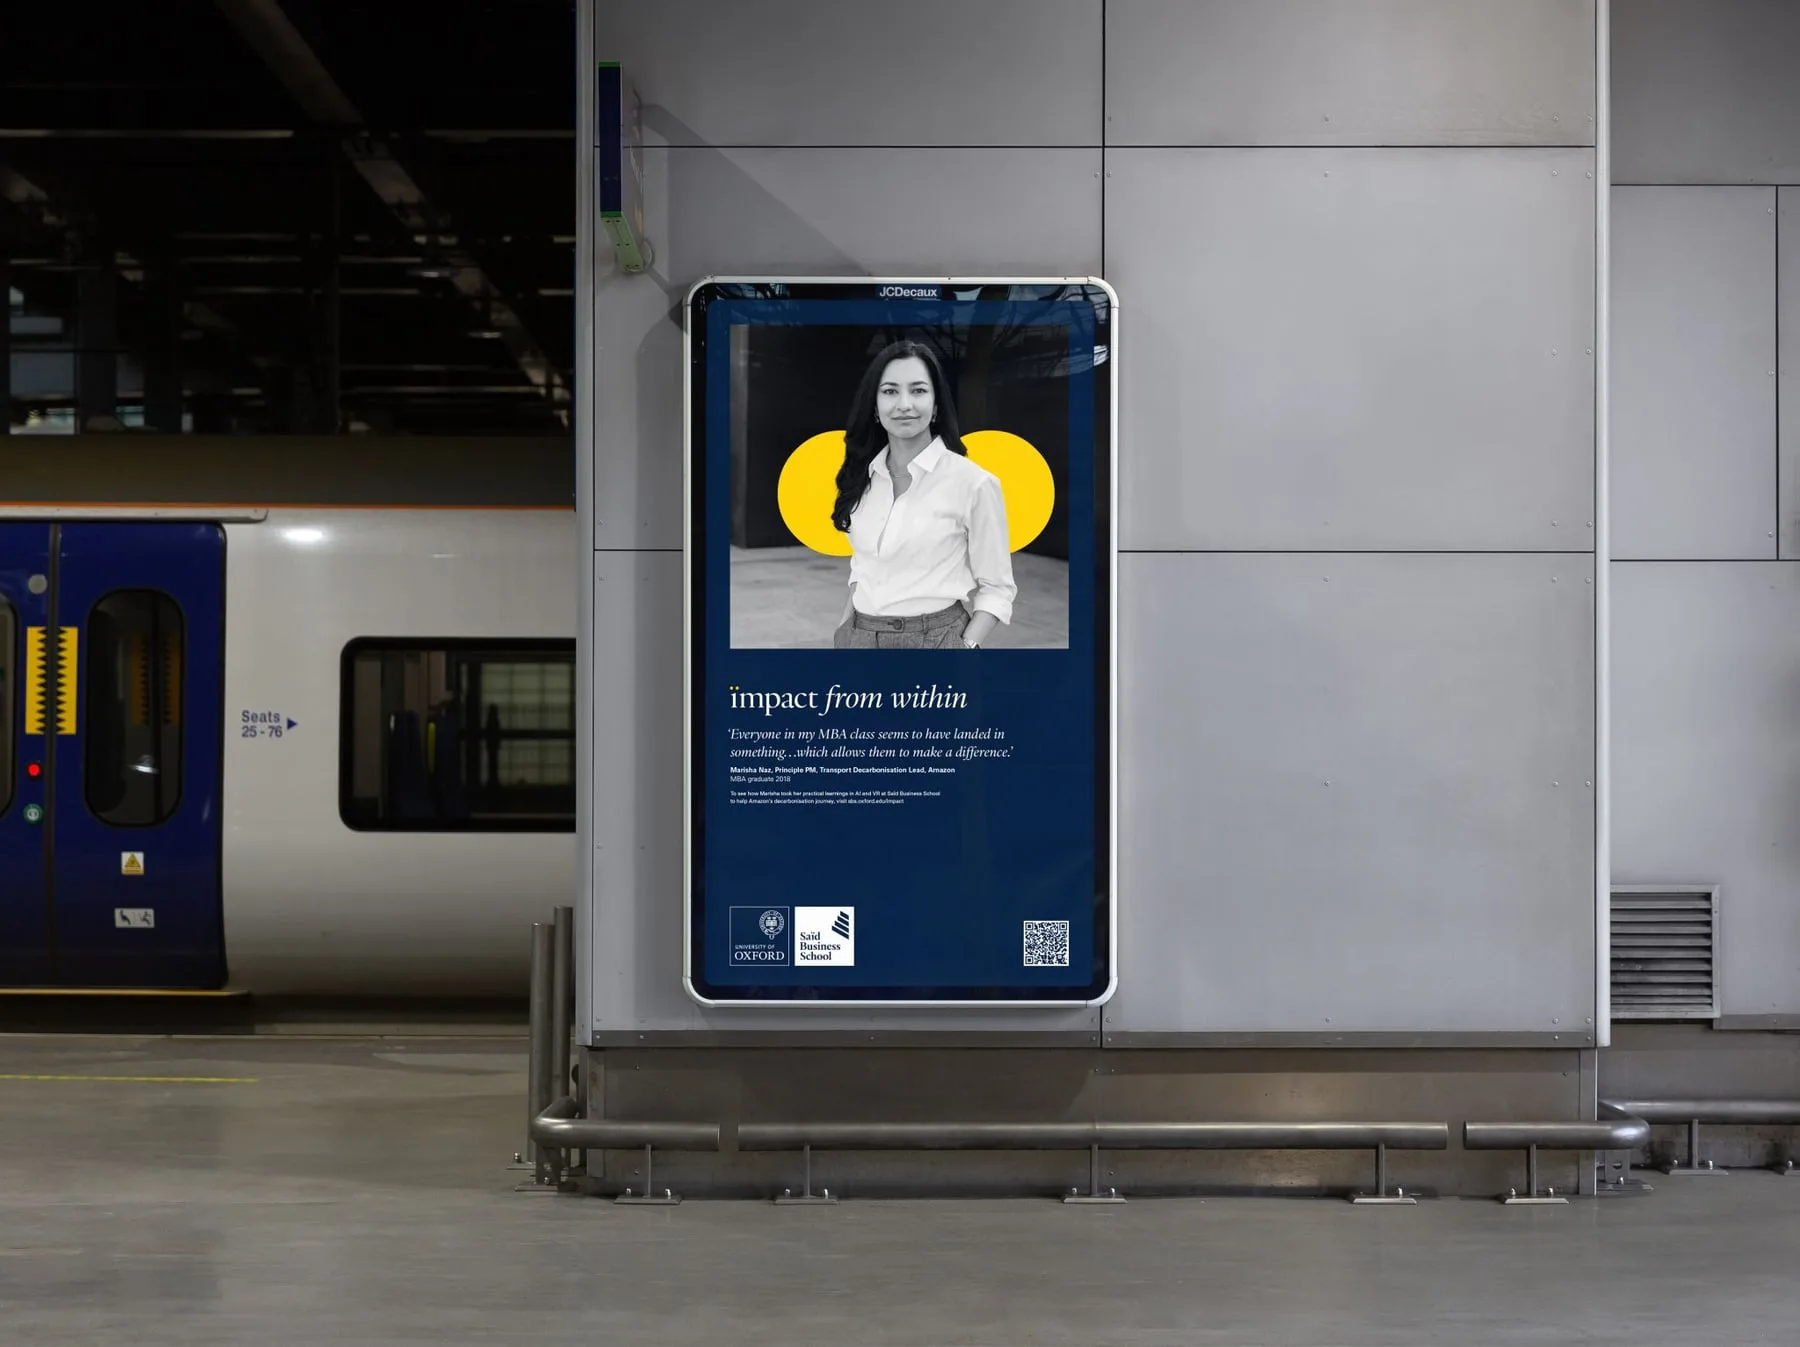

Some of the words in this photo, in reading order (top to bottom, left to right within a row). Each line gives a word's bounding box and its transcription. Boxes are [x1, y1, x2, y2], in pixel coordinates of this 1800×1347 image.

[879, 286, 938, 297] JCDecaux
[818, 684, 883, 716] from
[890, 684, 968, 709] within
[241, 709, 281, 723] Seats
[241, 725, 258, 738] 25
[268, 725, 284, 738] 76
[784, 728, 795, 740] in
[798, 731, 816, 743] my
[818, 728, 847, 740] MBA
[849, 727, 875, 740] class
[877, 731, 909, 740] seems
[911, 730, 923, 740] to
[925, 727, 951, 740] have
[953, 727, 992, 740] landed
[993, 728, 1005, 740] in
[830, 745, 866, 758] allows
[868, 745, 896, 758] them
[898, 748, 910, 758] to
[912, 745, 943, 758] make
[945, 749, 953, 758] a
[730, 766, 757, 774] Marisha
[758, 766, 774, 775] Naz,
[775, 766, 804, 775] Principle
[805, 766, 818, 775] PM,
[819, 766, 852, 775] Transport
[853, 766, 907, 774] Decarbonisation
[908, 766, 927, 775] Lead,
[928, 766, 956, 774] Amazon
[730, 775, 747, 783] MBA
[747, 775, 774, 784] graduate
[775, 775, 792, 783] 2018
[799, 931, 821, 941] Saïd
[799, 941, 841, 951] Business
[734, 950, 785, 961] OXFORD
[799, 951, 832, 961] School
